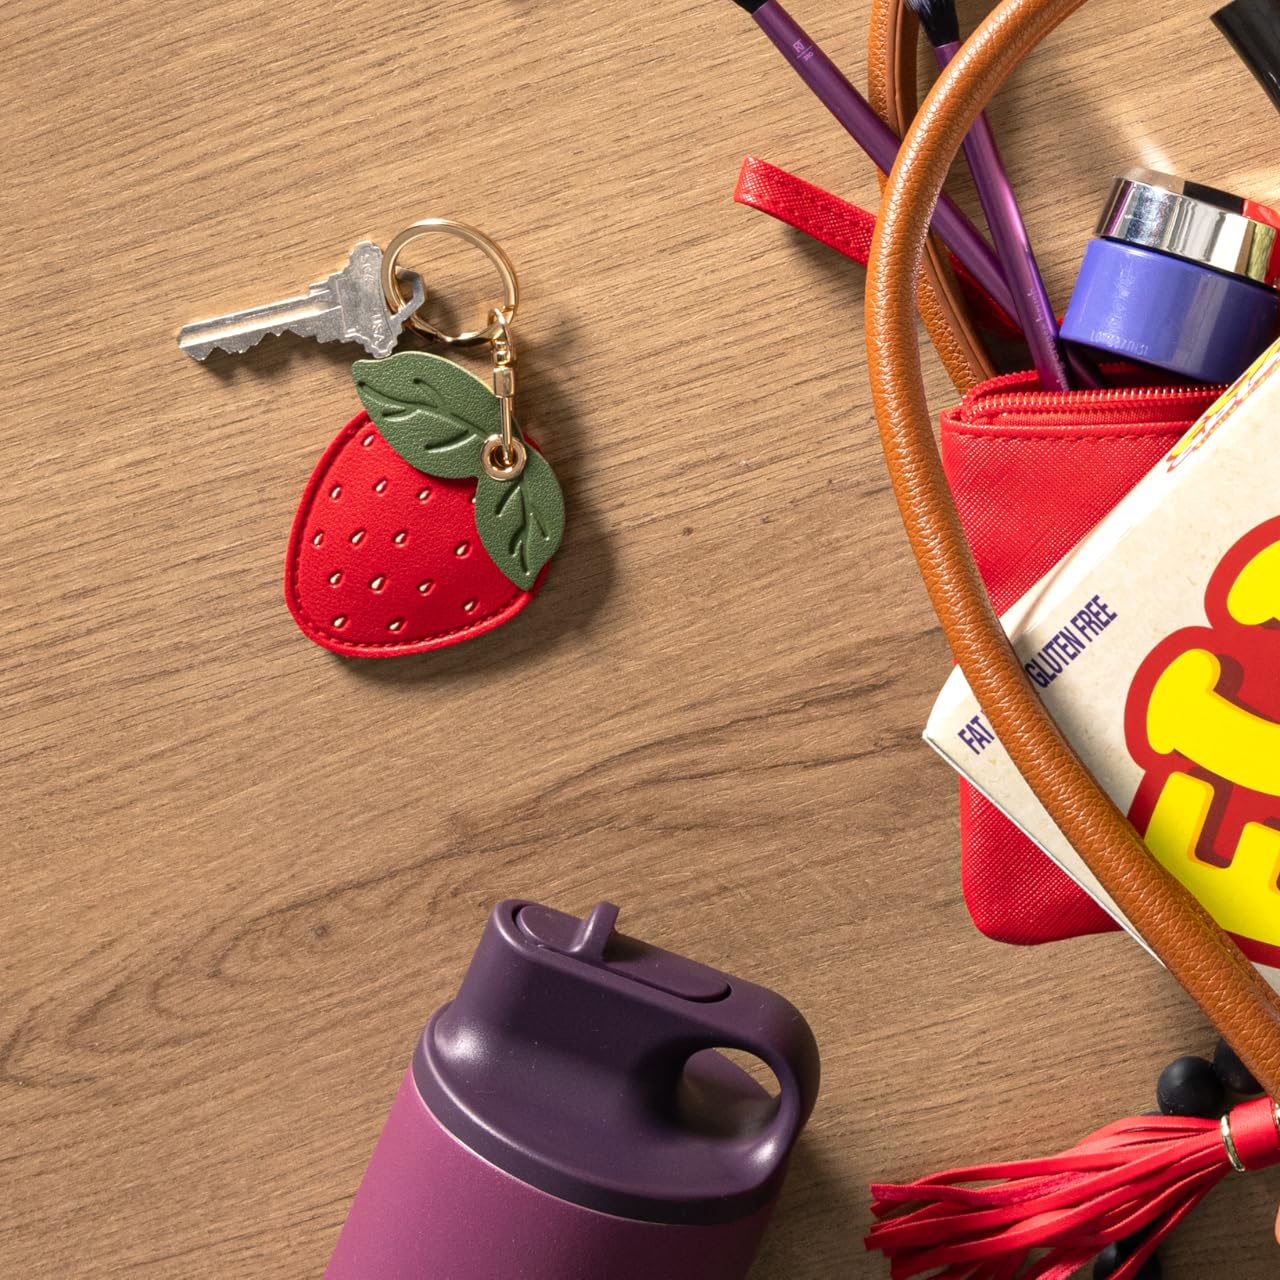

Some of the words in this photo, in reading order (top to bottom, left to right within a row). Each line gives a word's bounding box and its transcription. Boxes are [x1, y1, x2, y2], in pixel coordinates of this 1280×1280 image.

[1024, 626, 1086, 688] GLUTEN
[1070, 594, 1118, 642] FREE
[957, 715, 995, 755] FAT
